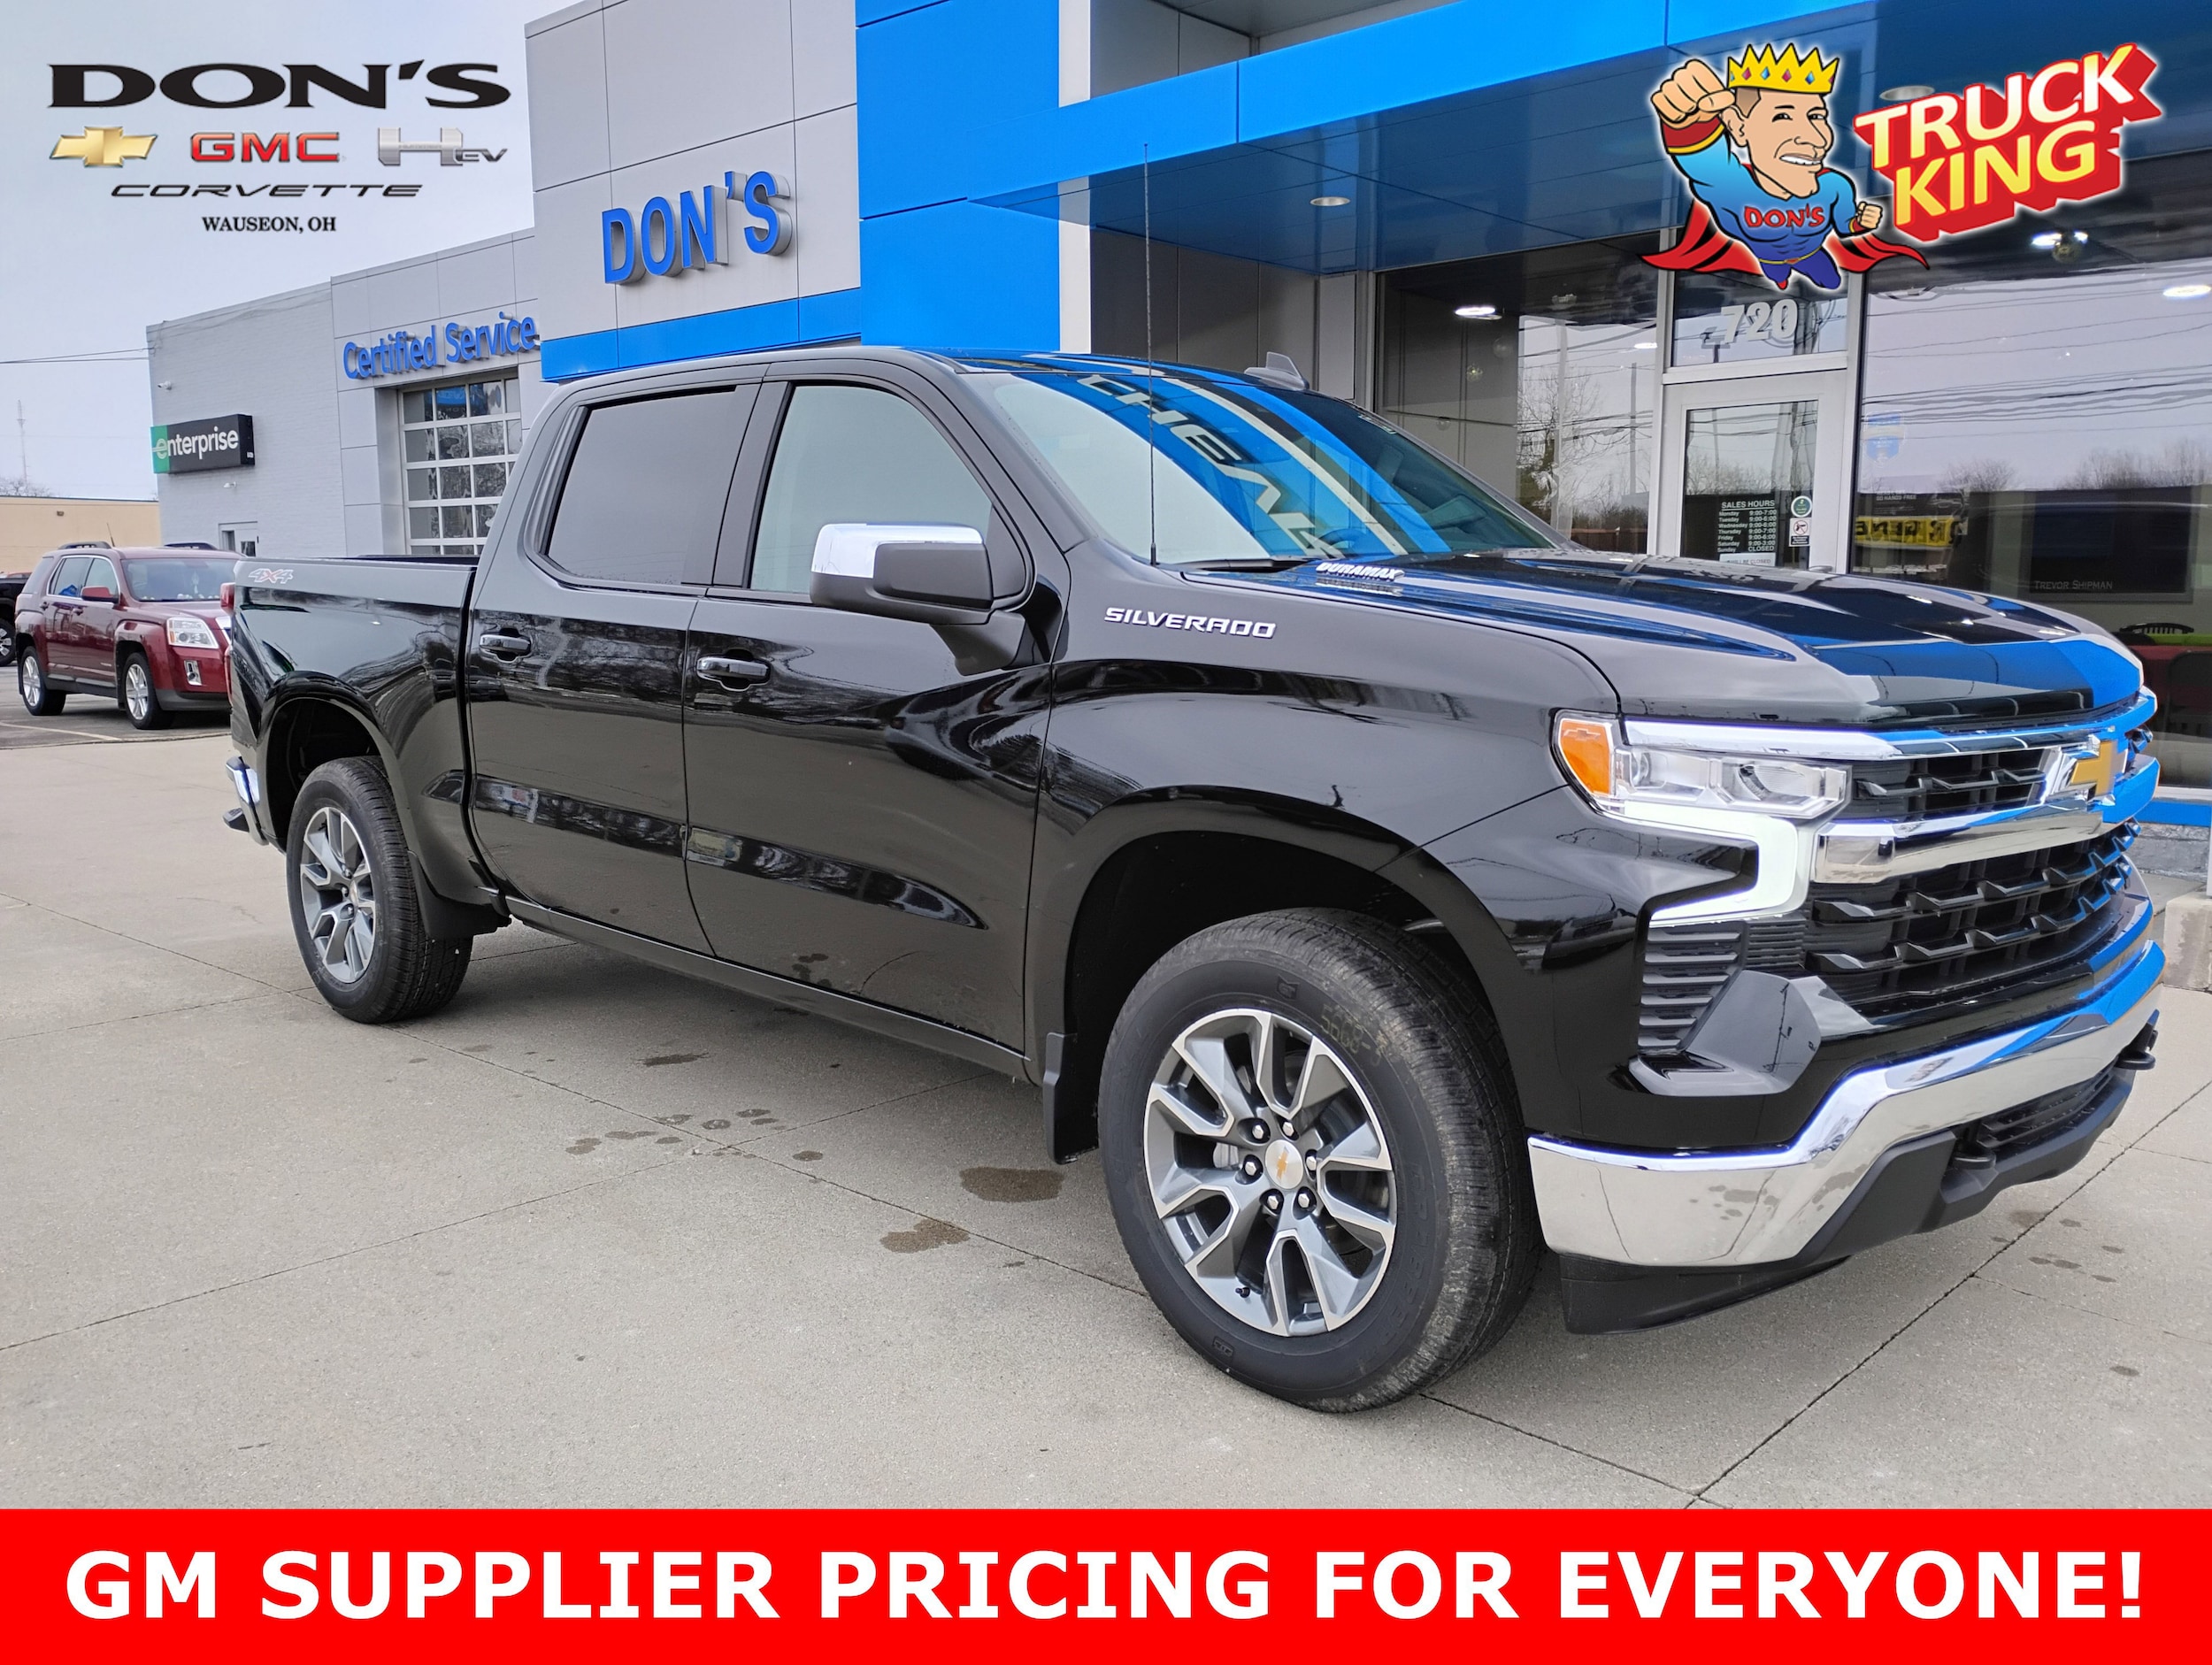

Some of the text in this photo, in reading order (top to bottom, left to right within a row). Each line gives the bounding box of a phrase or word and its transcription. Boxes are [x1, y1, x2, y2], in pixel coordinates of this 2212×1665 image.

[602, 171, 787, 285] DON'S
[1720, 299, 1798, 344] 720
[342, 311, 537, 380] Certified Service
[151, 426, 239, 460] enterprise
[1316, 562, 1397, 580] DURAMAX
[1104, 607, 1276, 638] SILVERADO
